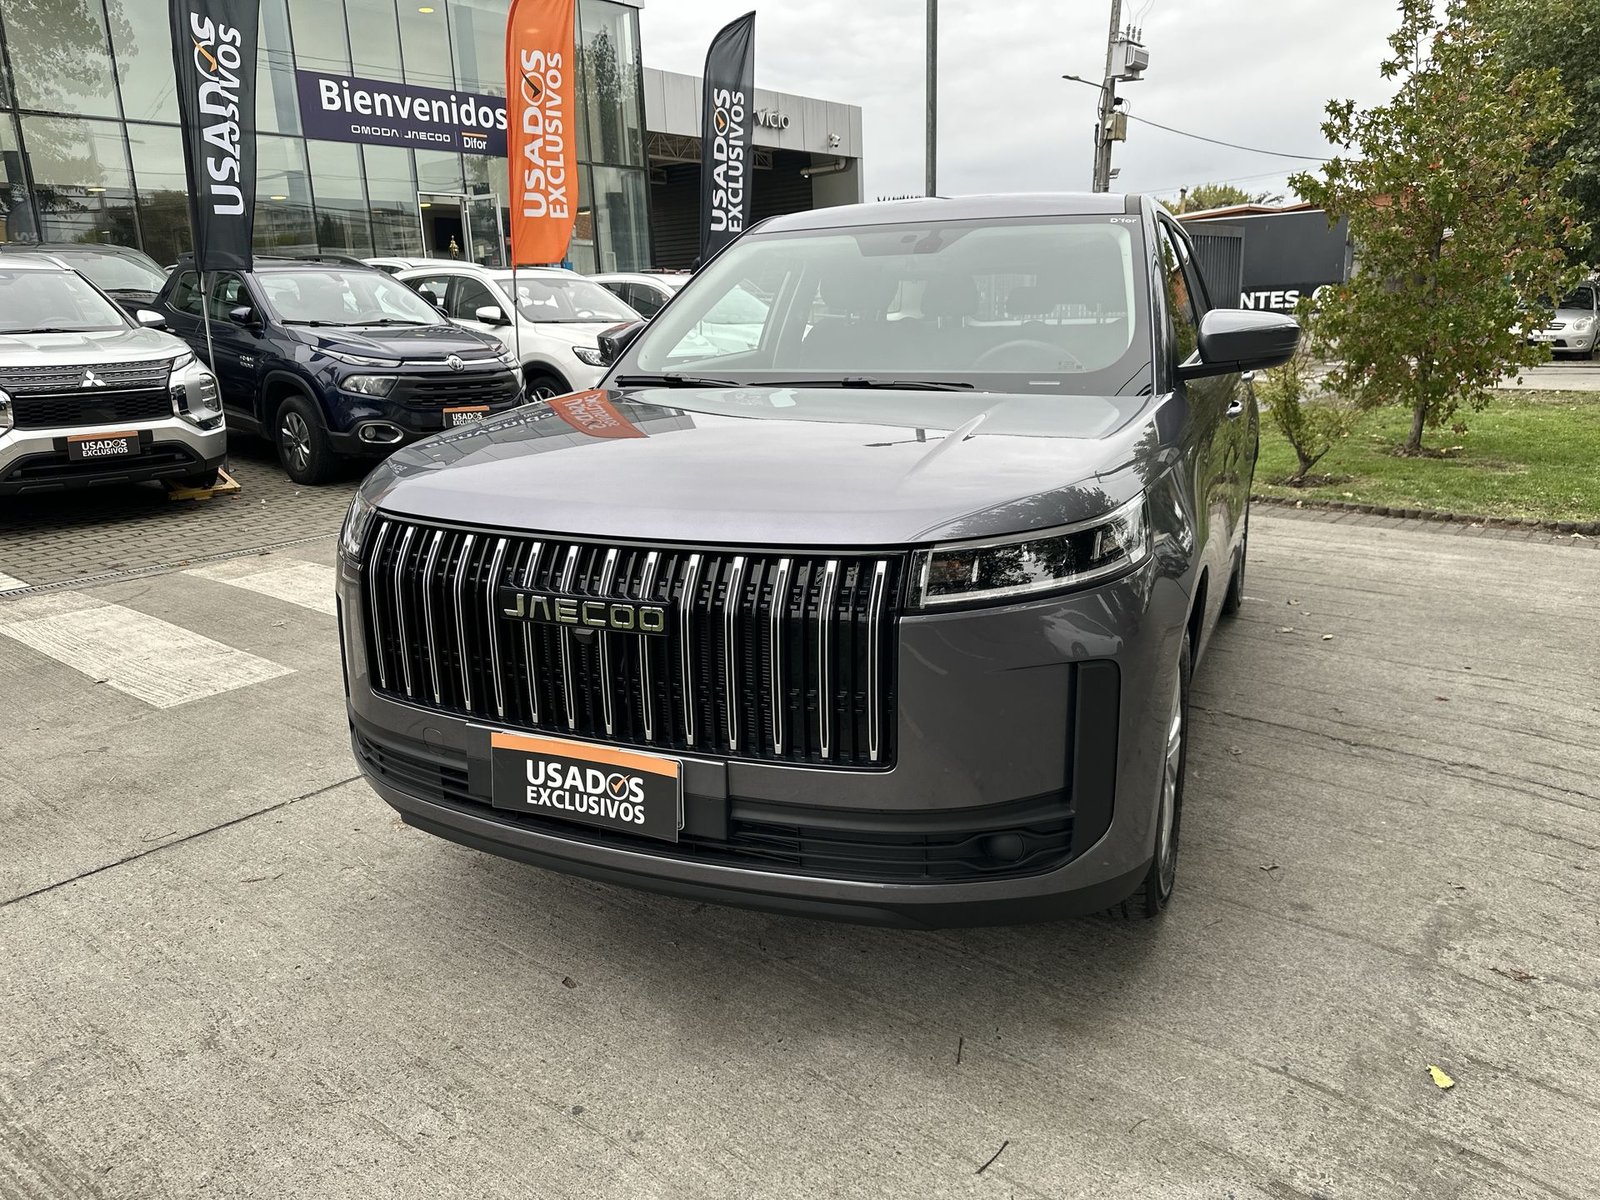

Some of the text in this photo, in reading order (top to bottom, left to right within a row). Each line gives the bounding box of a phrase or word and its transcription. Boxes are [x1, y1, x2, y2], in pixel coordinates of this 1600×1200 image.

[190, 12, 244, 216] USADOS
[318, 78, 508, 130] Bienvenidos
[351, 124, 451, 143] OMODA JAECOO
[463, 137, 487, 150] Difor
[520, 48, 548, 218] USADOS
[545, 52, 570, 219] EXCLUSIVOS
[711, 88, 730, 232] USADOS
[728, 90, 744, 233] EXCLUSIVOS
[452, 412, 482, 421] USADOS
[81, 438, 127, 450] USADOS
[82, 447, 128, 457] EXCLUSIVOS
[503, 593, 664, 632] JAECOO
[526, 759, 645, 803] USADOS
[526, 785, 645, 825] EXCLUSIVOS
